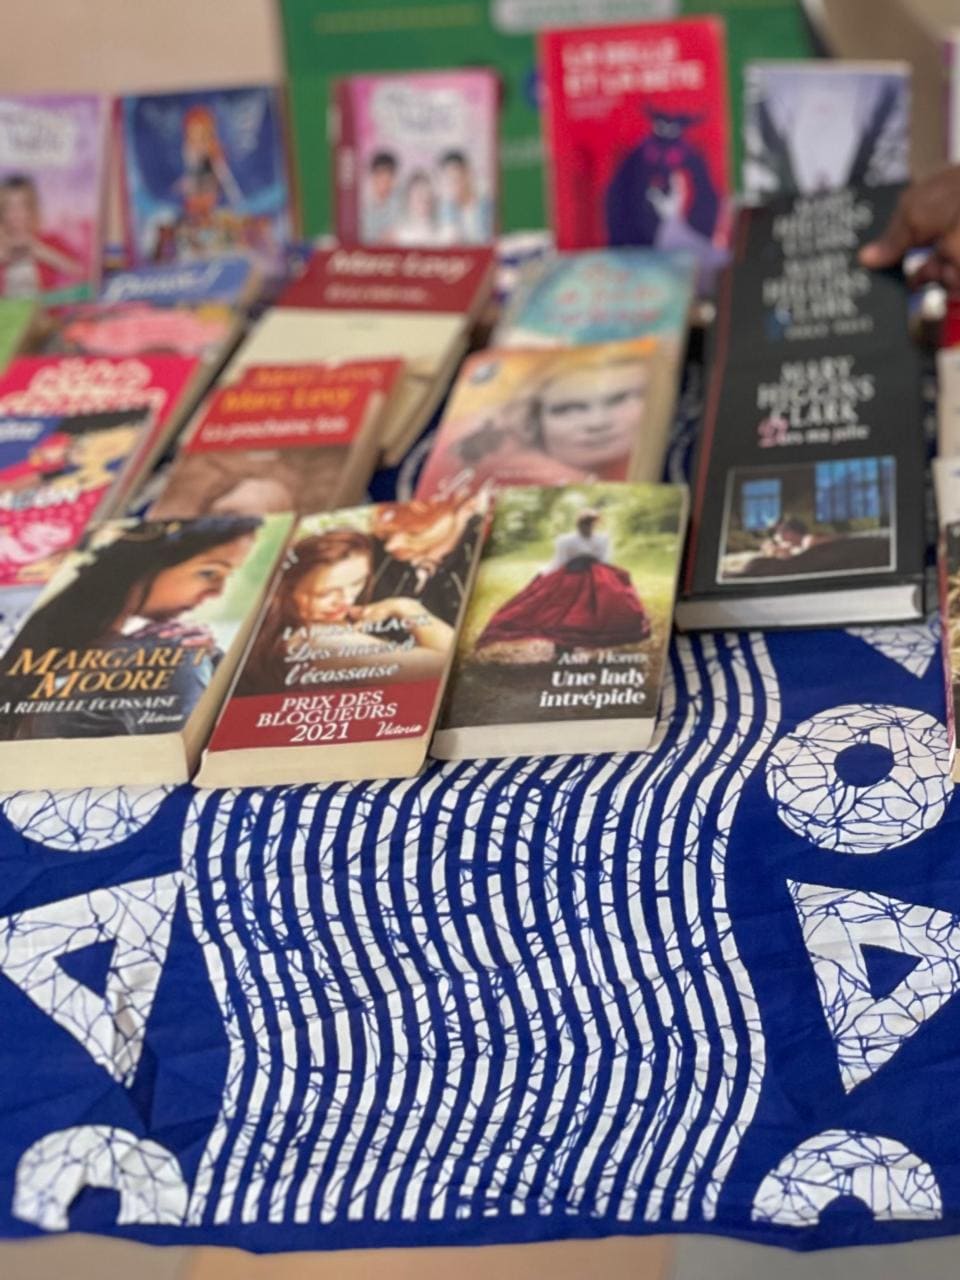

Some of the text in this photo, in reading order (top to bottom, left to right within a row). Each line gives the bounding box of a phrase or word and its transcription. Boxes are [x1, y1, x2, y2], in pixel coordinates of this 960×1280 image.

[780, 355, 855, 382] MARY
[221, 386, 355, 413] Marc Levy
[757, 374, 876, 410] HIGGINS
[770, 397, 859, 428] CLARK
[6, 647, 208, 677] MARGARET
[284, 662, 400, 687] l'écossaise
[28, 670, 175, 700] MOORE
[552, 667, 646, 689] Une lady
[281, 690, 385, 713] PRIX DES
[539, 687, 647, 709] intrépide
[256, 702, 399, 728] BLOGUEURS
[290, 721, 349, 743] 2021
